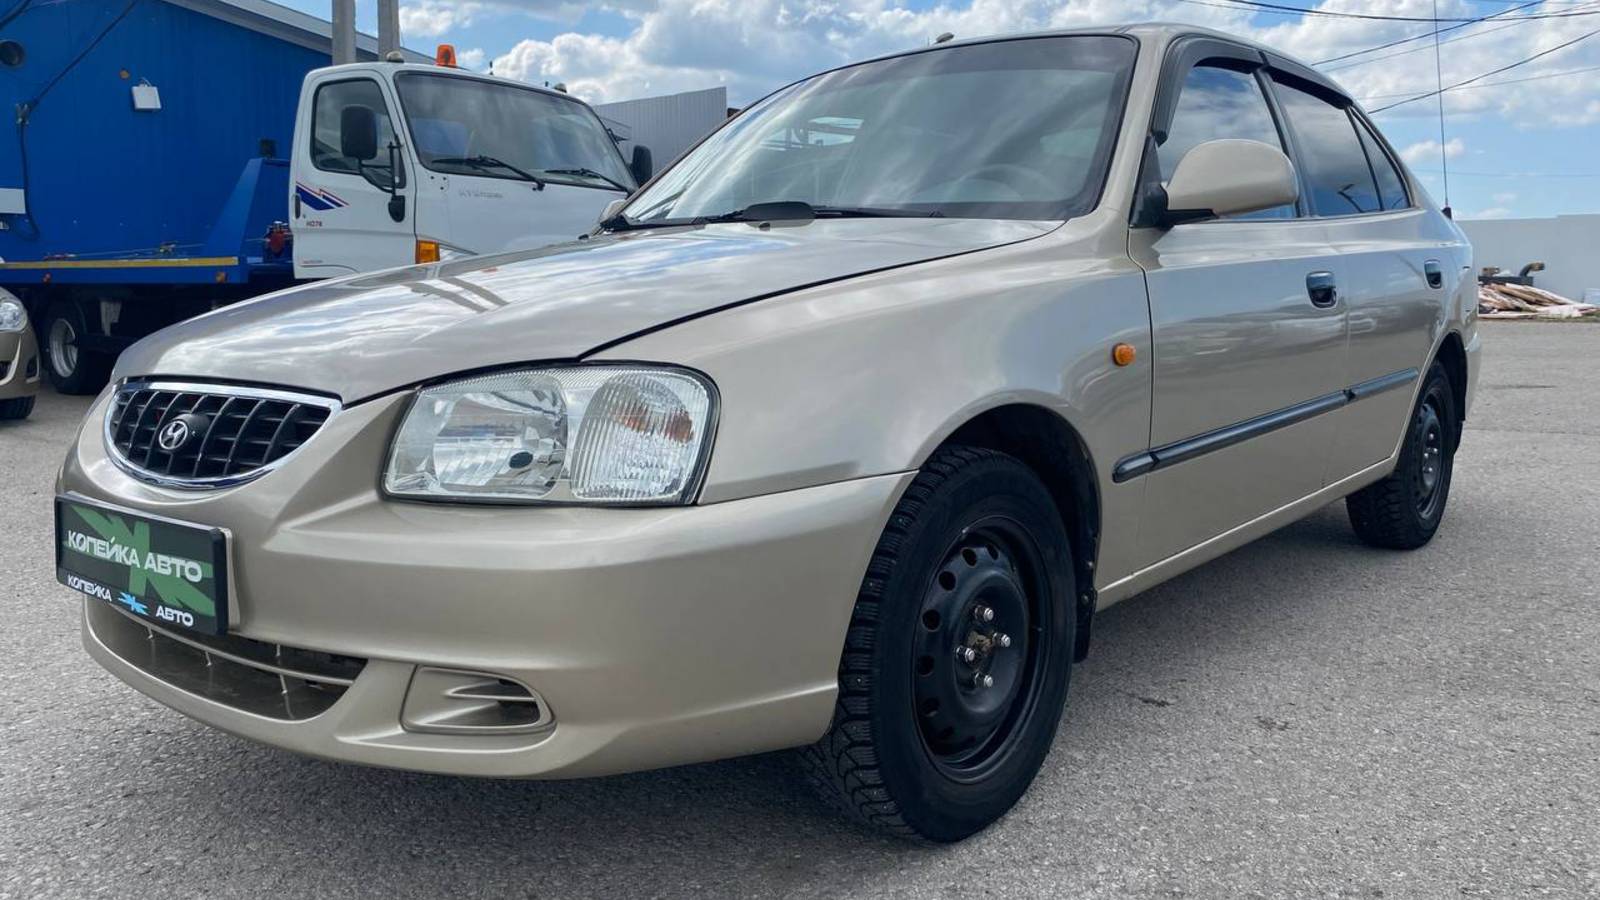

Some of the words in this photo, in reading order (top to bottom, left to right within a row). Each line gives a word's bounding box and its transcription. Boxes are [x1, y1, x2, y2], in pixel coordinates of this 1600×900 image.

[68, 530, 141, 569] КОПЕЙКА
[144, 552, 202, 583] АВТО
[68, 574, 112, 602] КОПЕЙКА
[155, 605, 194, 627] АВТО
